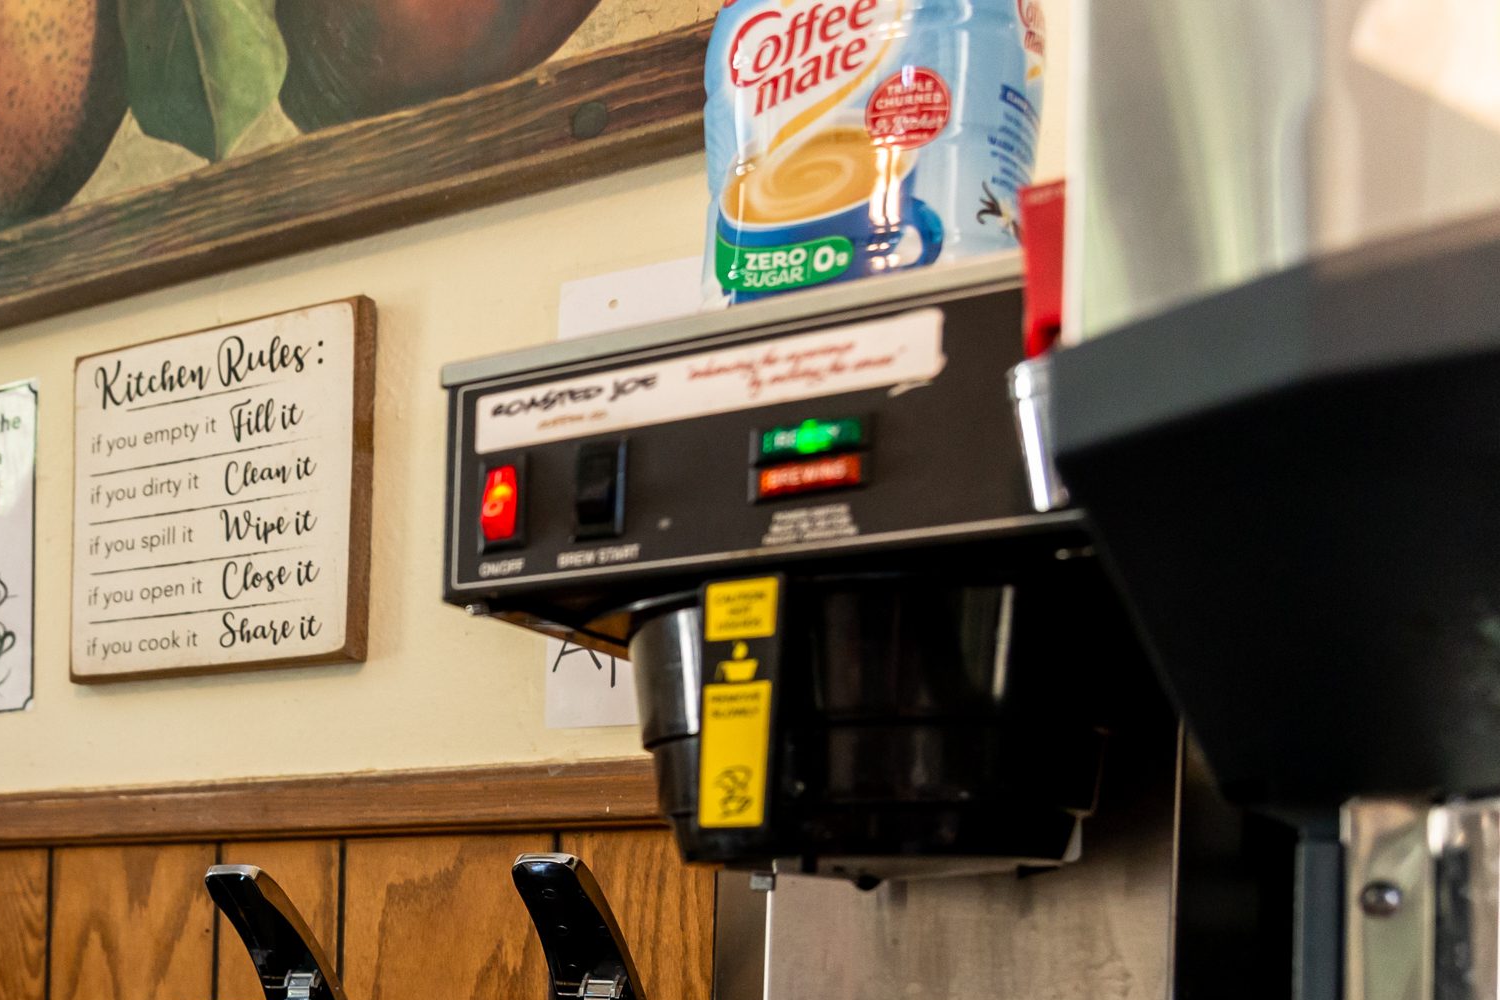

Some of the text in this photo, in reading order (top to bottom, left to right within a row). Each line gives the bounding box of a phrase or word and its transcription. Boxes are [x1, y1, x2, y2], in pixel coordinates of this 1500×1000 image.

[729, 0, 877, 87] Coffee
[754, 38, 867, 117] mate
[742, 266, 804, 288] SUGAR
[744, 247, 807, 270] ZERO
[94, 359, 211, 410] Kitchen
[490, 374, 658, 418] ROASTED JOE
[91, 397, 305, 457] if you empty it Fill it
[90, 456, 317, 508] if you dirty it Clean it
[89, 508, 318, 559] if you spill it Wipe it
[88, 560, 320, 610] if you open it Close it
[86, 610, 323, 660] if you cook it Share it
